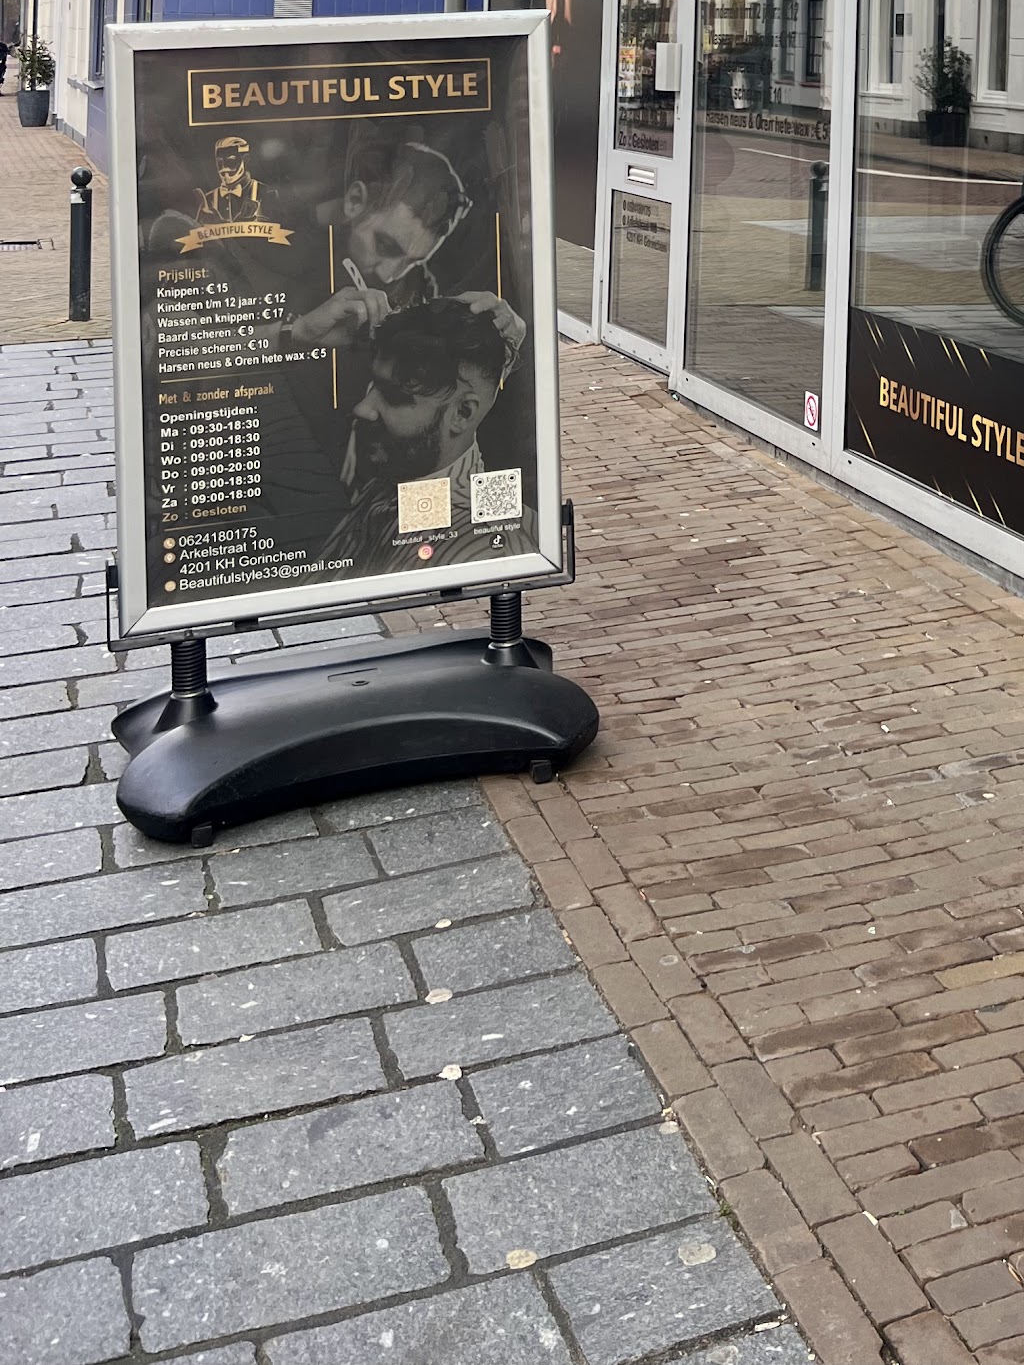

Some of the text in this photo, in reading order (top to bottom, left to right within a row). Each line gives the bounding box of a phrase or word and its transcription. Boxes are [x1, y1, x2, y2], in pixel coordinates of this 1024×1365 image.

[202, 72, 479, 109] BEAUTIFUL STYLE
[196, 223, 274, 240] BEAUTIFUL STYLE
[157, 300, 203, 314] Kinderen
[205, 298, 222, 309] t/m
[224, 297, 236, 308] 12
[157, 316, 197, 328] Wassen
[199, 315, 213, 325] en
[215, 311, 255, 325] knippen
[158, 331, 188, 344] Baard
[190, 328, 231, 341] scheren
[158, 345, 200, 359] Precisie
[201, 342, 242, 356] scheren
[158, 361, 195, 374] Harsen
[197, 359, 222, 370] neus
[224, 357, 233, 367] &
[234, 355, 259, 366] Oren
[261, 352, 283, 364] hete
[285, 352, 305, 362] wax
[158, 383, 275, 405] Met & zonder afspraak
[879, 376, 967, 442] BEAUTIFUL
[160, 427, 179, 438] Ma
[189, 418, 260, 435] 09:30-18:30
[160, 441, 175, 452] Di
[190, 432, 260, 449] 09:00-18:30
[160, 455, 182, 466] Wo
[190, 445, 261, 463] 09:00-18:30
[161, 470, 180, 480] Do
[190, 459, 261, 477] 09:00-20:00
[161, 484, 176, 494] Vr
[190, 473, 261, 491] 09:00-18:30
[161, 498, 178, 509] Za
[191, 487, 262, 505] 09:00-18:00
[161, 512, 179, 523] Zo
[192, 504, 247, 519] Gesloten
[178, 527, 258, 548] 0624180175
[473, 525, 504, 535] beautiful
[179, 538, 275, 561] Arkelstraat 100
[179, 549, 307, 575] 4201 KH Gorinchem
[179, 557, 354, 591] Beautifulstyle33@gmail.com
